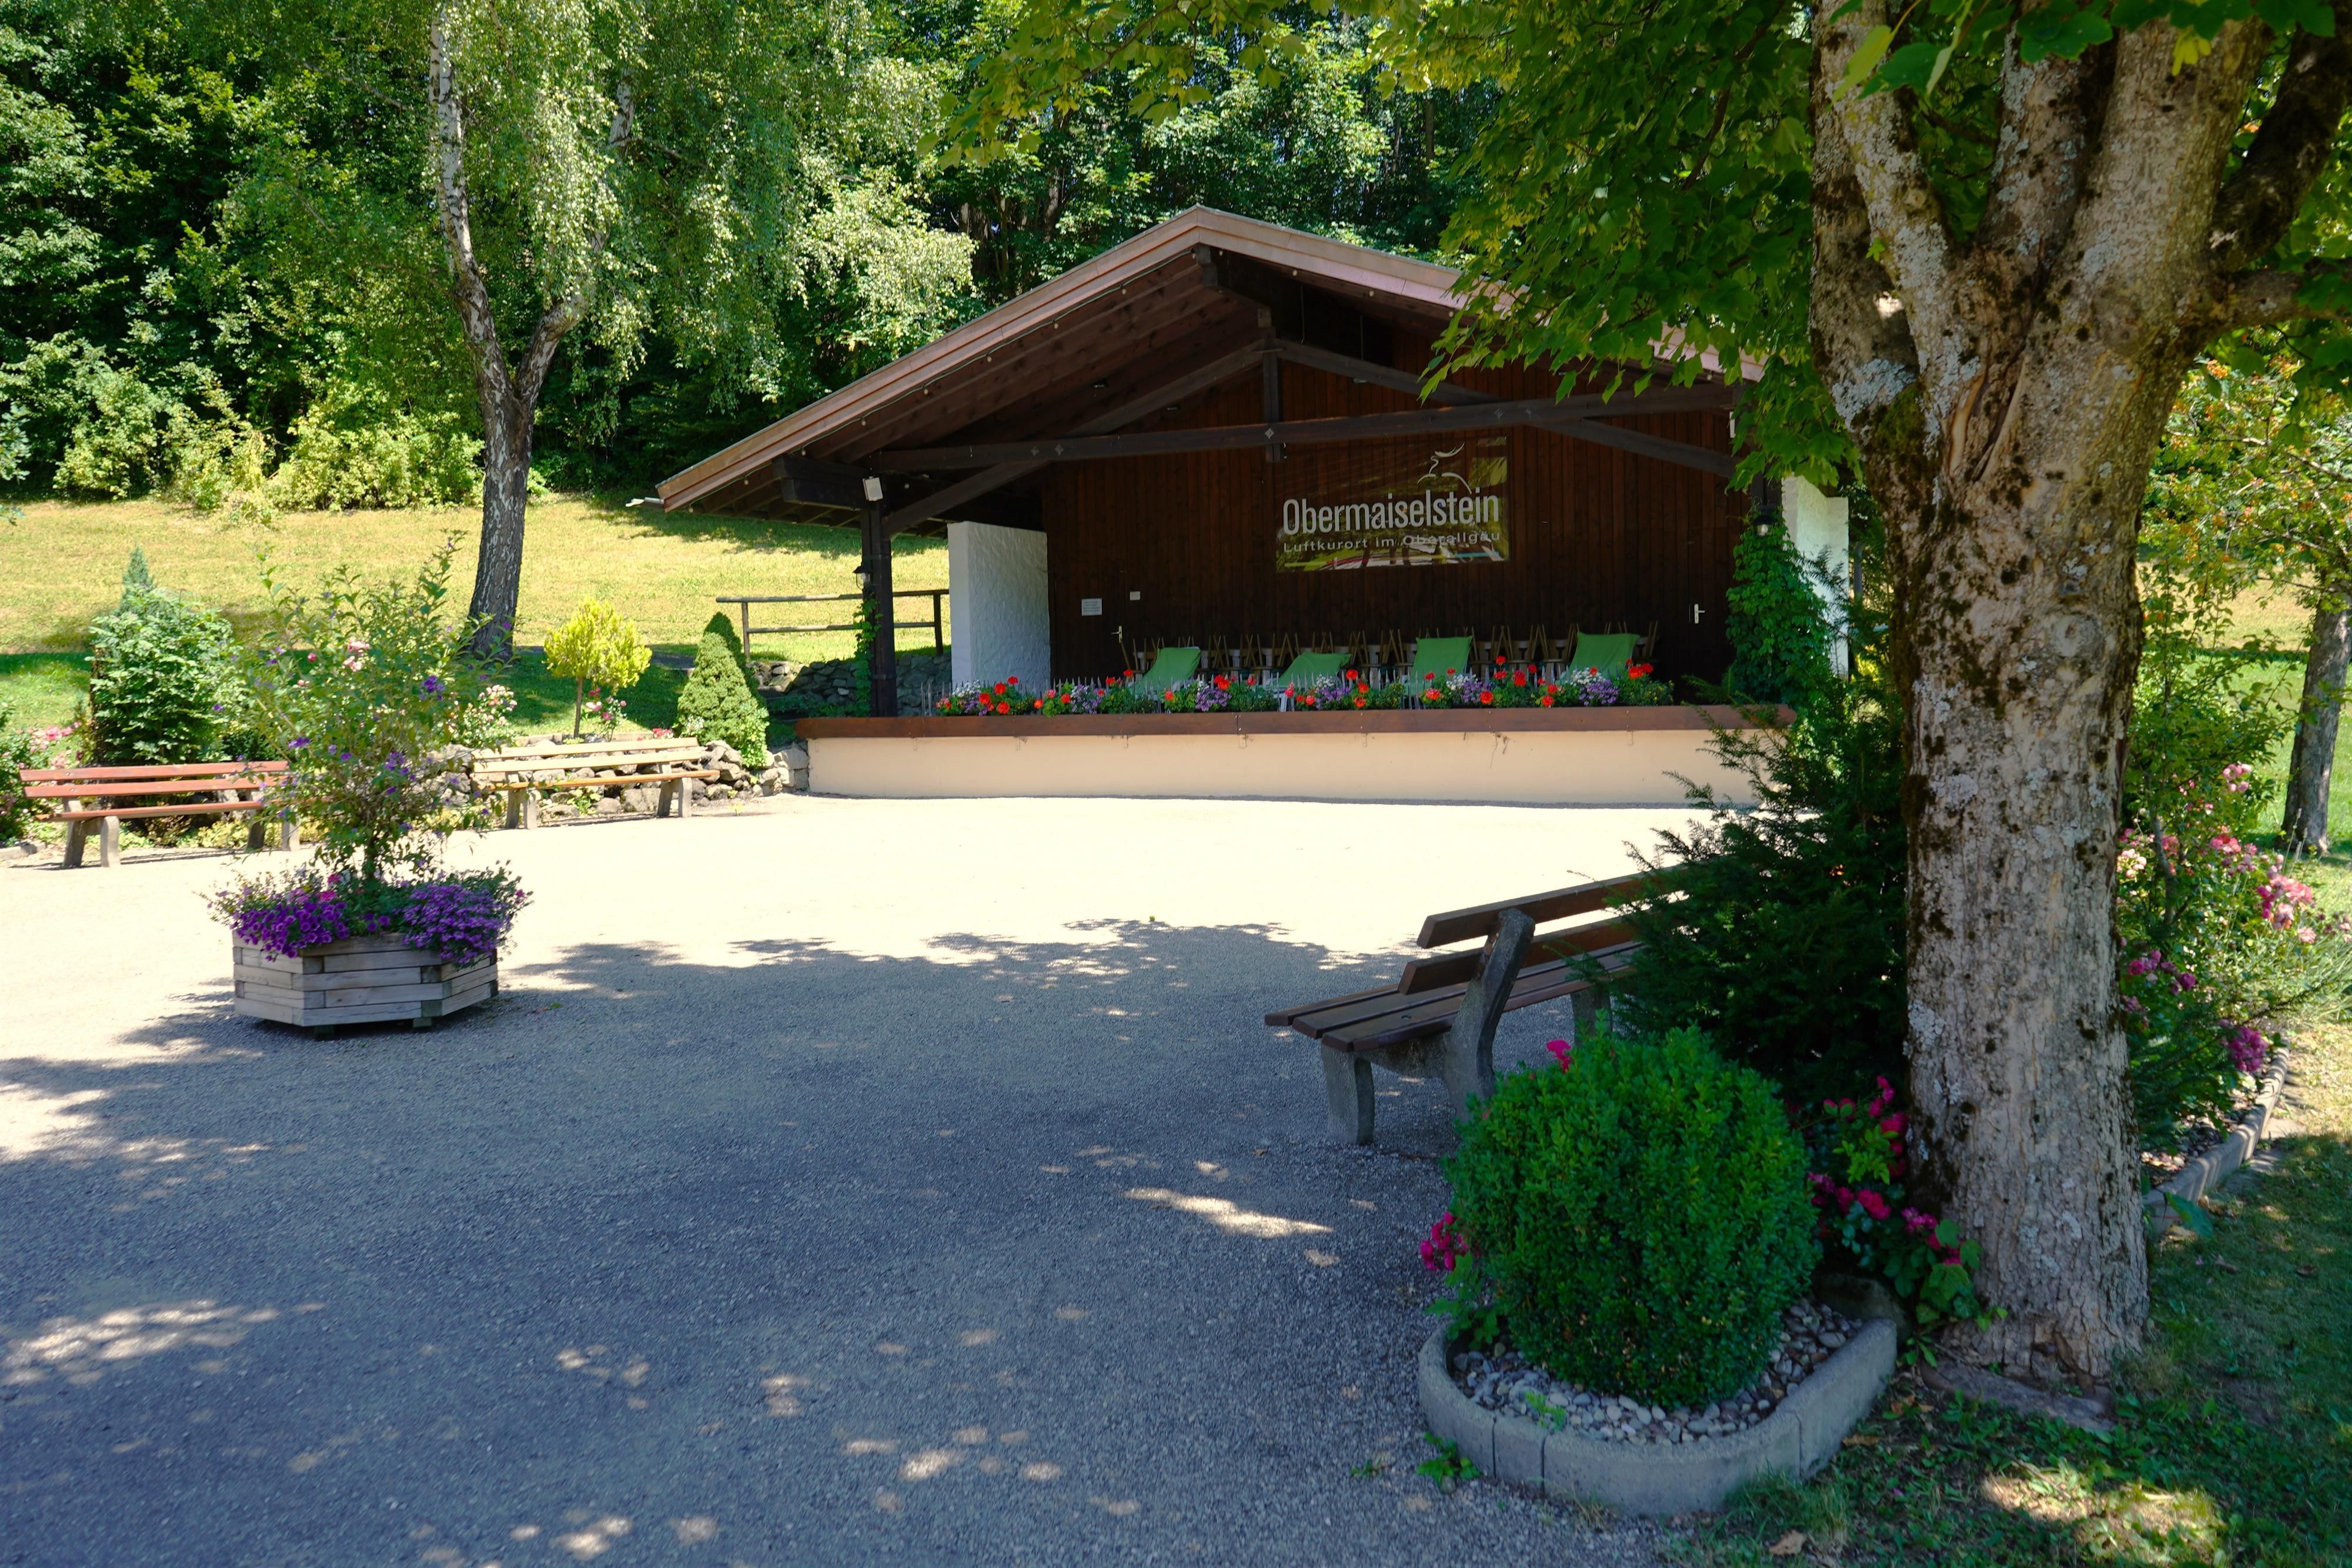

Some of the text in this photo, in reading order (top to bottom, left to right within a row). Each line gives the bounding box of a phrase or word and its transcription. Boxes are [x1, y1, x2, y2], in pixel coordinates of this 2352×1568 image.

[1283, 487, 1500, 535] Obermaiselstein
[1284, 531, 1501, 553] Luftkurort im Oberallgäu
